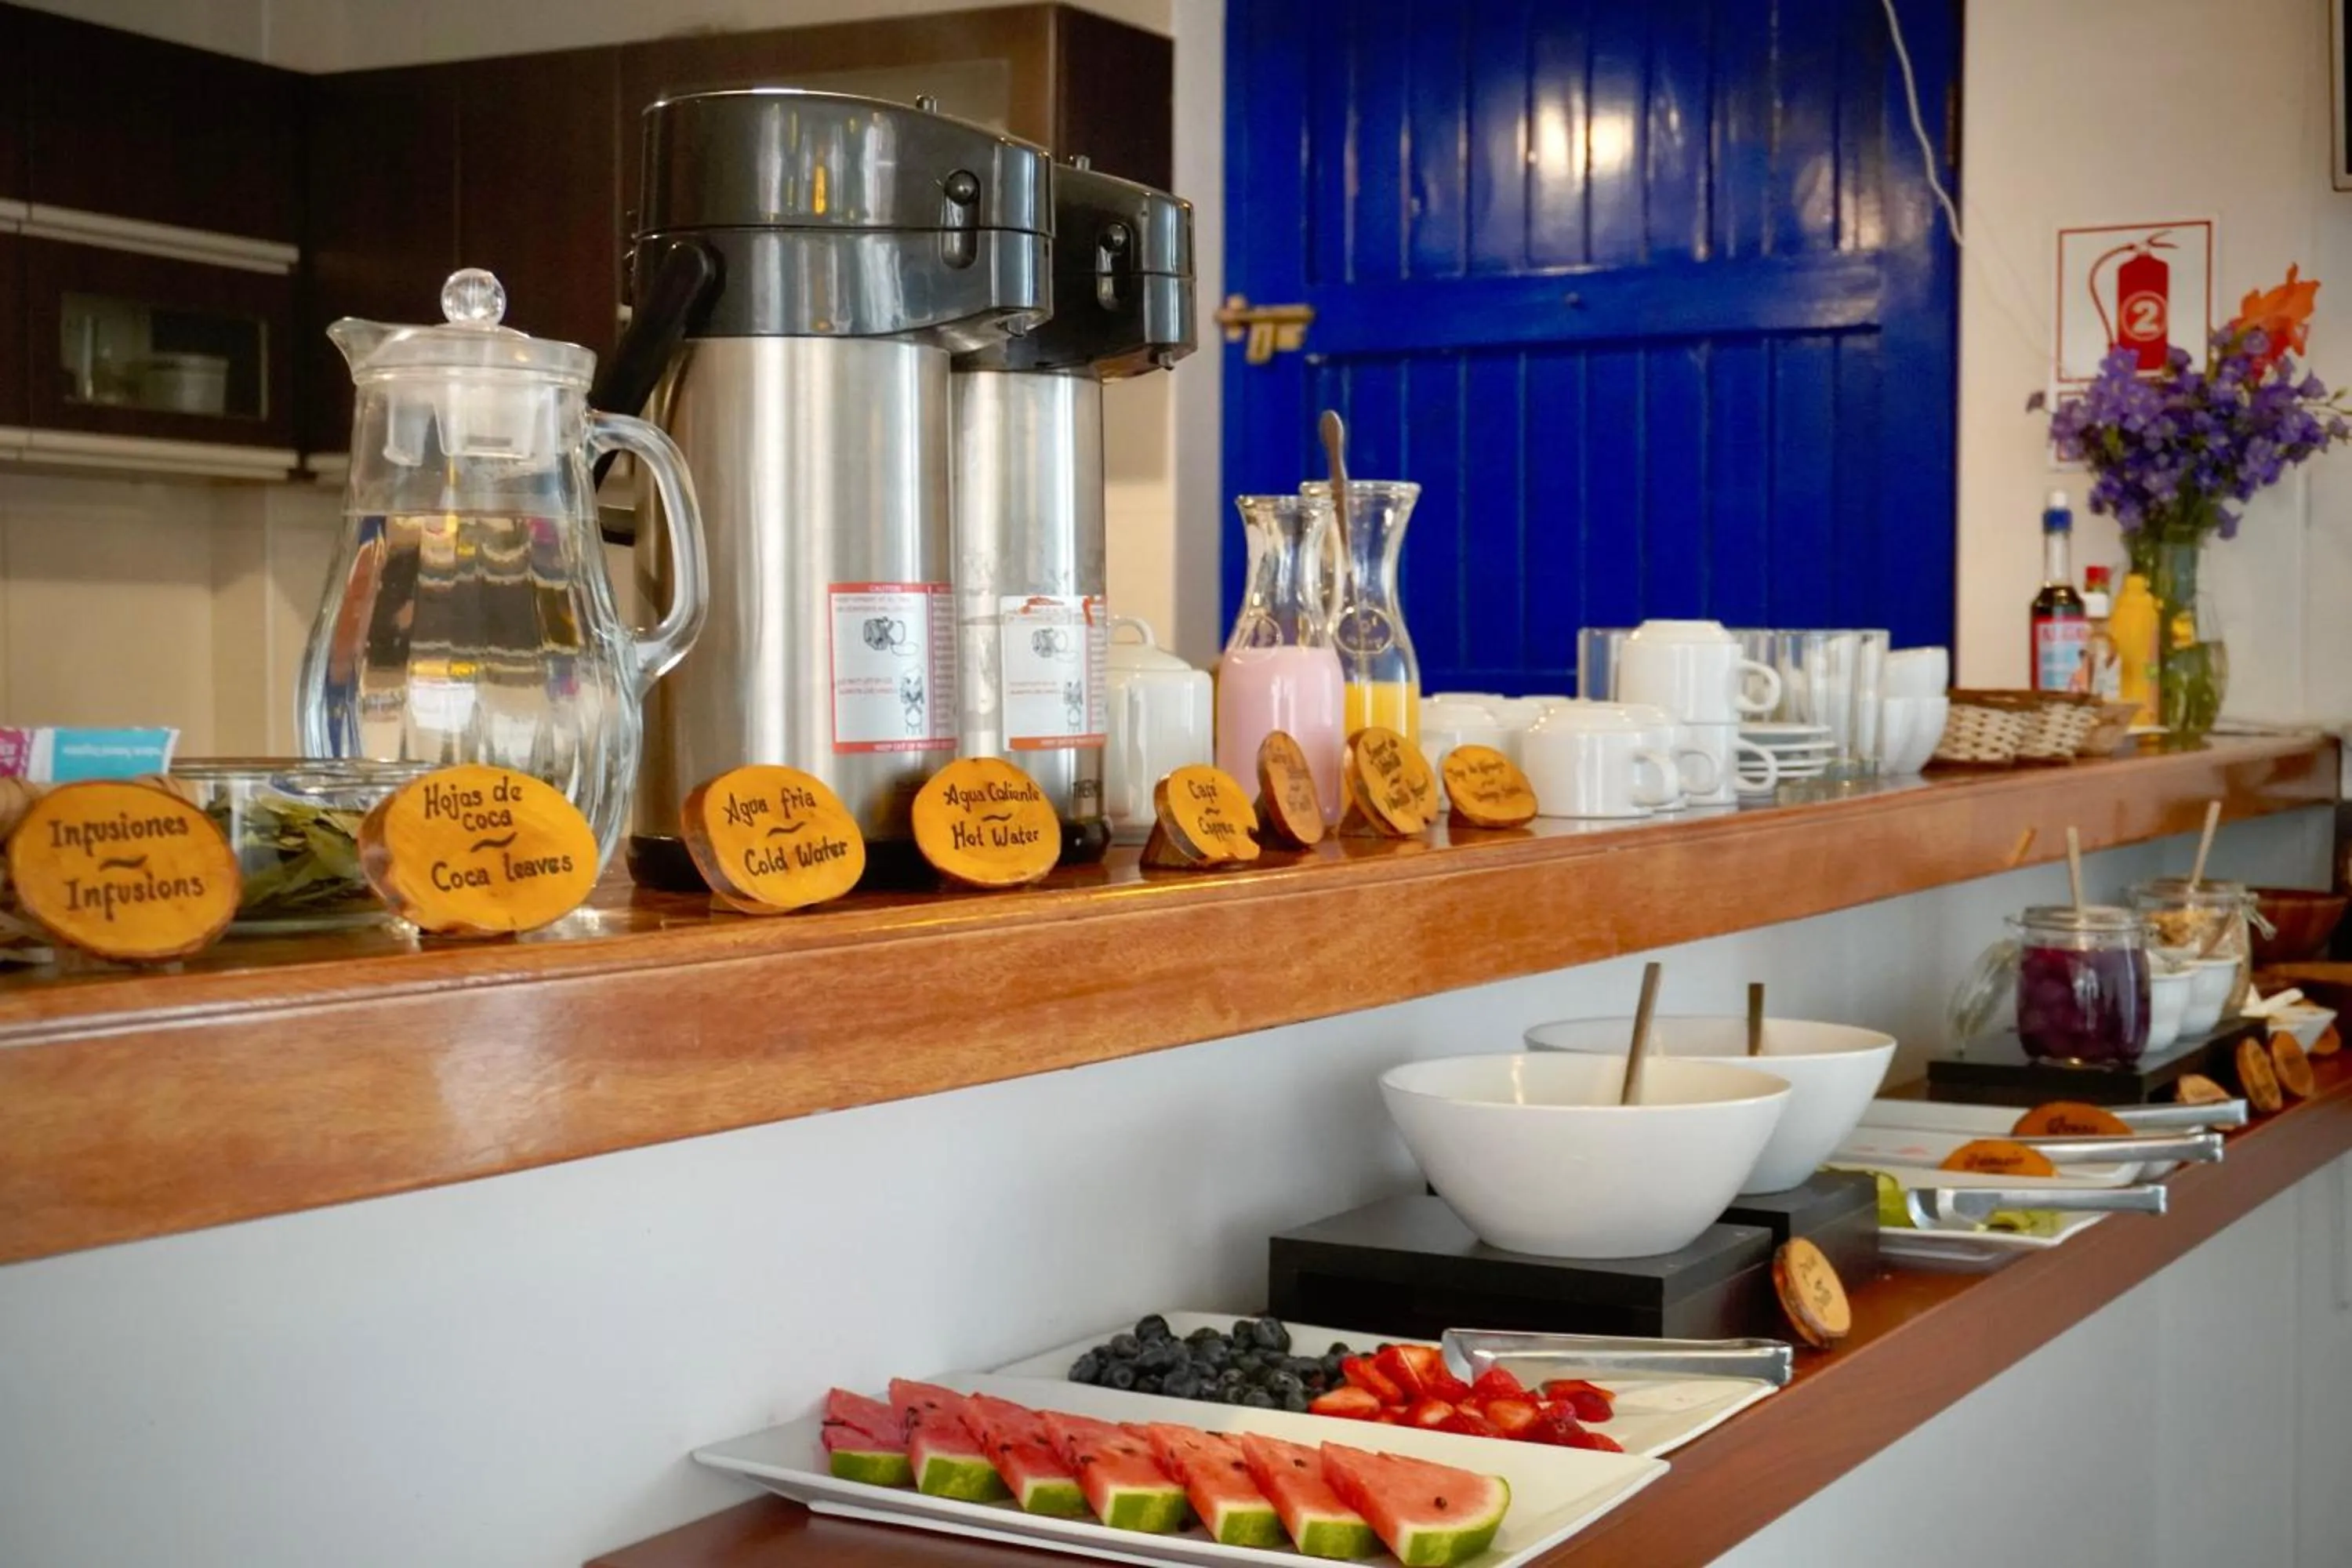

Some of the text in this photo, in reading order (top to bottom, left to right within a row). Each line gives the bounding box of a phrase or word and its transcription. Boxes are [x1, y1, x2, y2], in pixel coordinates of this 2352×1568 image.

[2132, 299, 2160, 335] 2
[423, 775, 523, 821] Hojas de
[721, 791, 769, 828] Agua
[942, 782, 986, 815] Agua
[47, 811, 190, 858] Infusiones
[462, 808, 514, 833] coca
[951, 820, 1040, 851] Hot Water
[744, 835, 848, 877] Cold Water
[430, 860, 491, 892] Coca
[63, 871, 205, 922] Infusions
